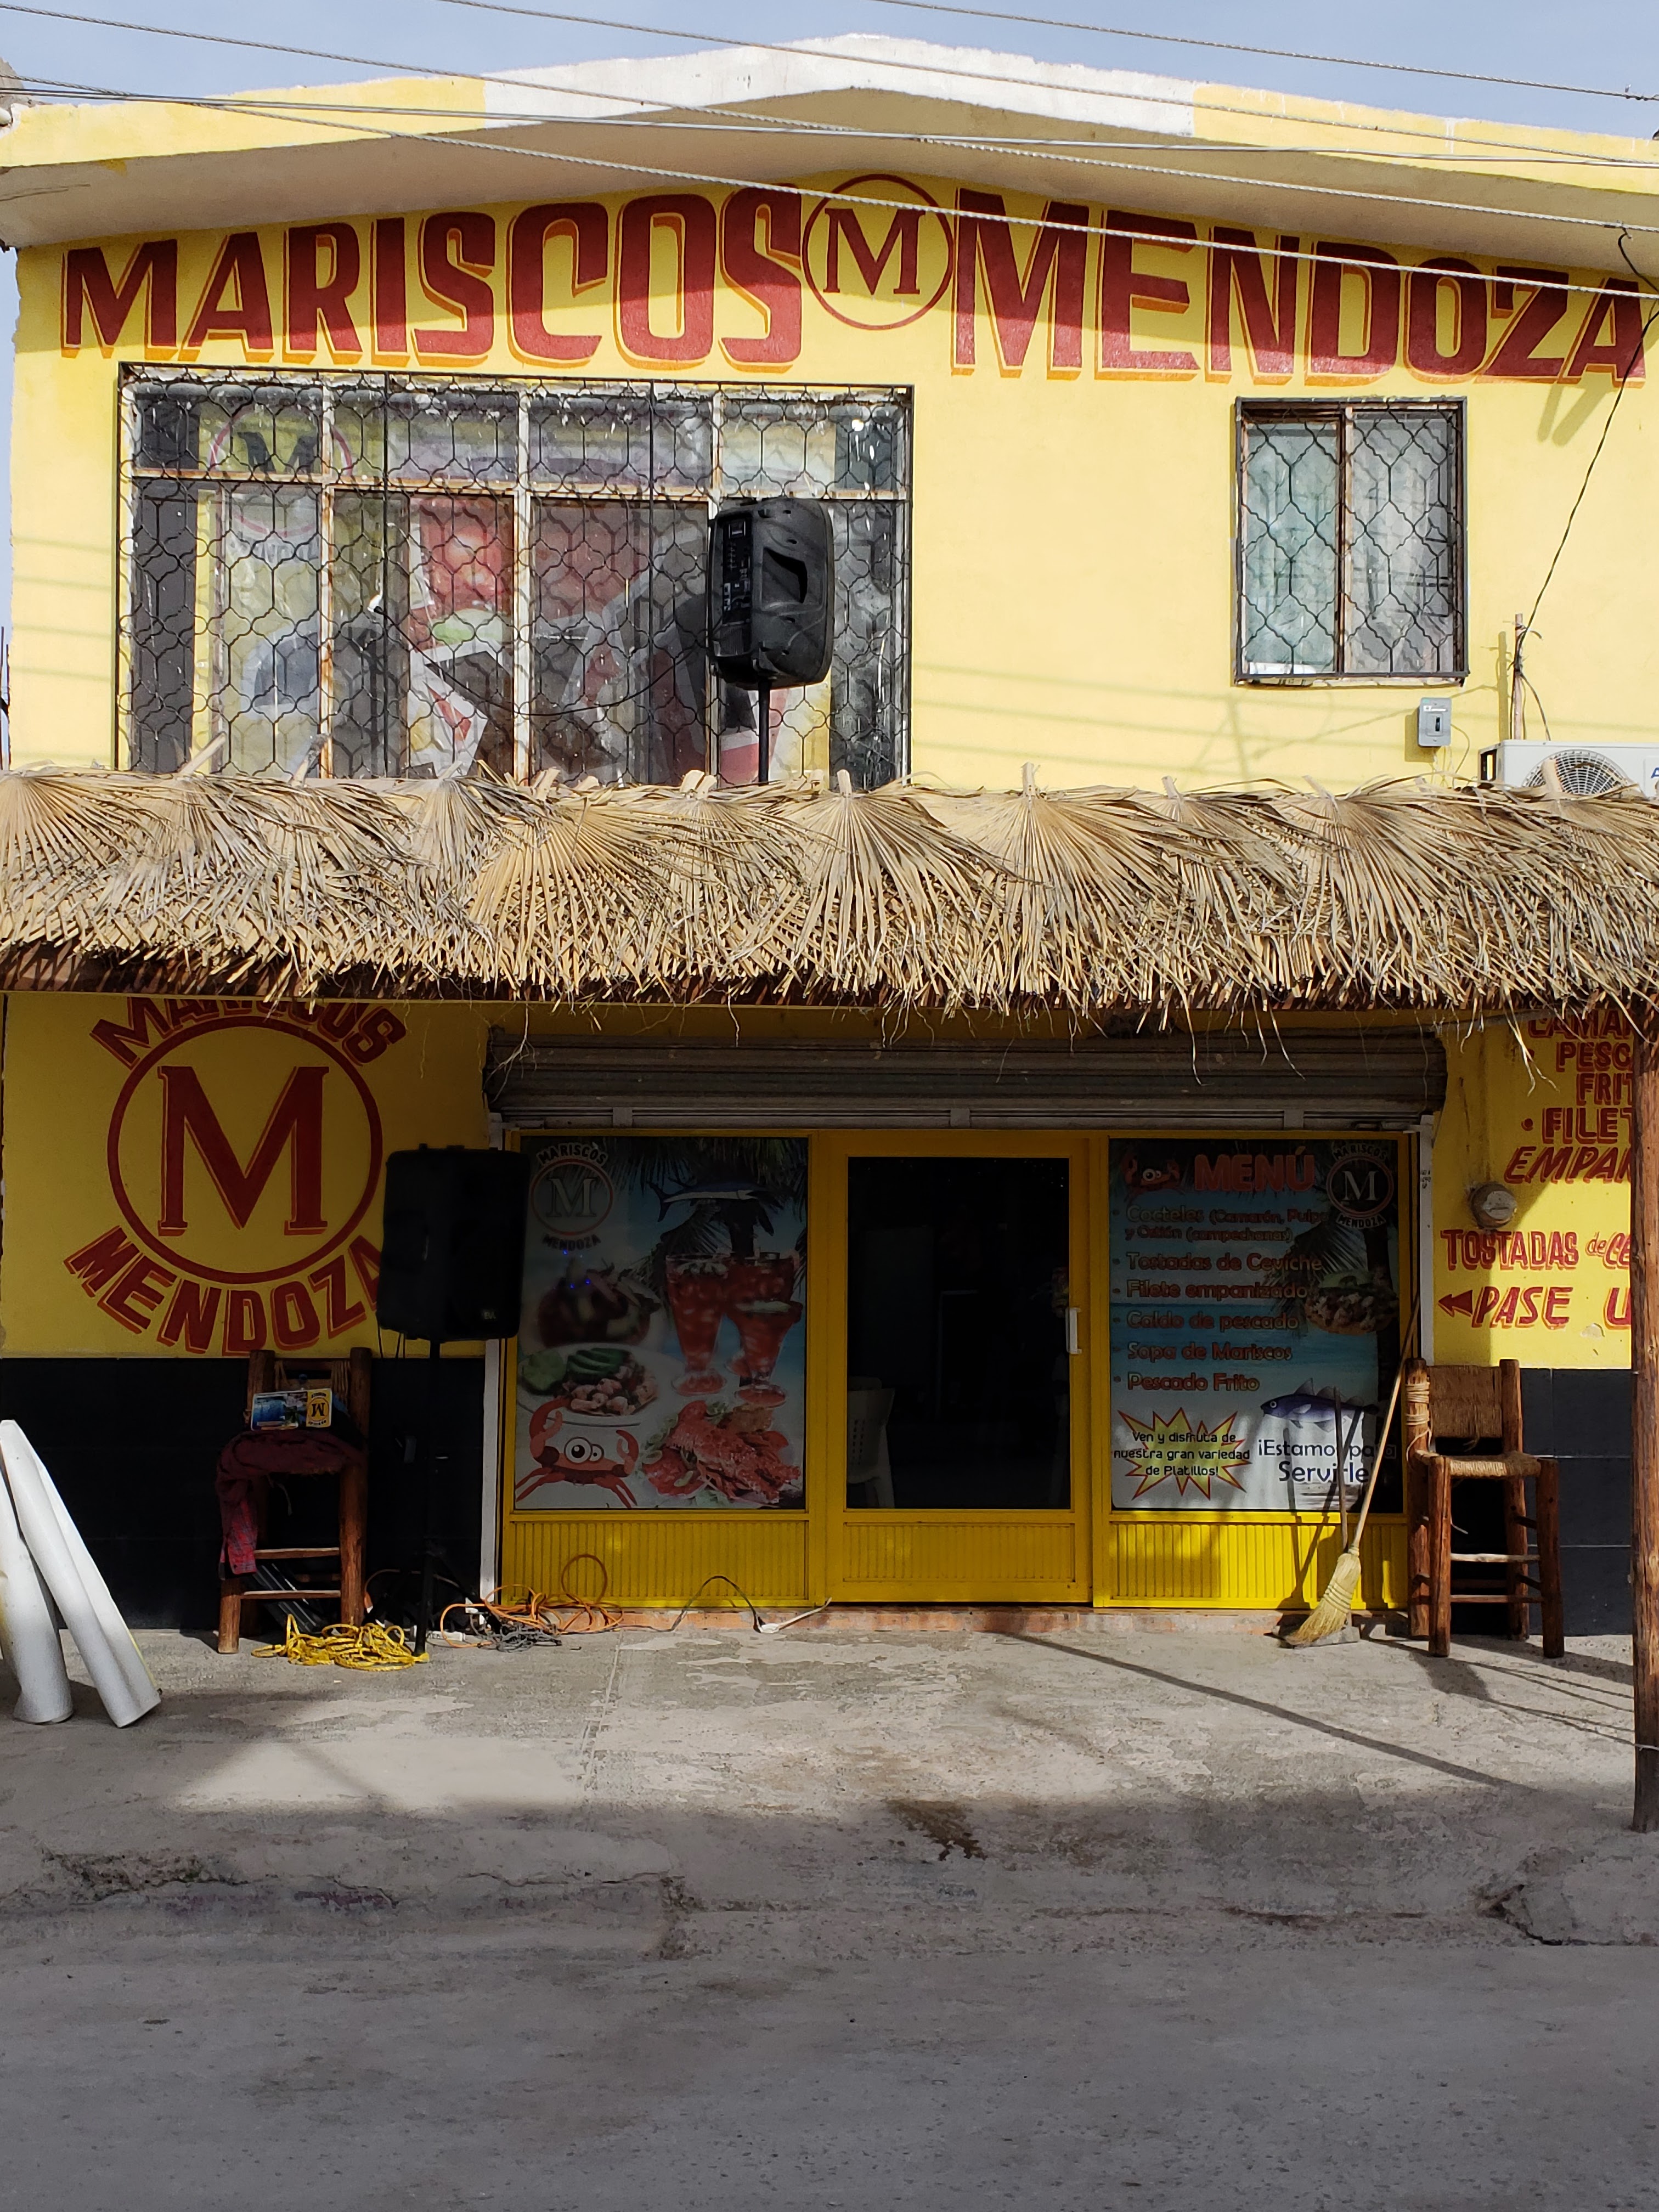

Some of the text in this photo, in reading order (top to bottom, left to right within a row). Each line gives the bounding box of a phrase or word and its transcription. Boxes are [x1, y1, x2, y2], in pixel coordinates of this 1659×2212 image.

[61, 183, 803, 373] MARISCOS
[951, 187, 1646, 388] MENDOZA
[89, 997, 407, 1067] MAOS
[158, 1065, 330, 1236] M
[538, 1144, 606, 1164] MARISCOS
[1333, 1144, 1387, 1159] MARISCOS
[1194, 1146, 1316, 1193] MENÚ
[1126, 1205, 1205, 1223] Cocteles
[1339, 1214, 1385, 1228] MENDOZA
[542, 1234, 602, 1251] MENDOZA
[1440, 1229, 1579, 1271] TOSTADAS
[1585, 1232, 1607, 1257] de
[1126, 1251, 1324, 1271] Tostadas de Ceviche
[1126, 1279, 1308, 1301] Filete empanizado
[1471, 1286, 1573, 1330] PASE
[1126, 1310, 1300, 1333] Caldo de pescado
[1127, 1341, 1293, 1363] Sopa de Mariscos
[1127, 1372, 1261, 1392] Pescado Frito
[1132, 1432, 1236, 1444] Ven y disfruta de
[1258, 1438, 1336, 1457] ¡Estamo
[1114, 1448, 1250, 1461] nuestra gran variedad
[1146, 1465, 1219, 1476] de Platillos!
